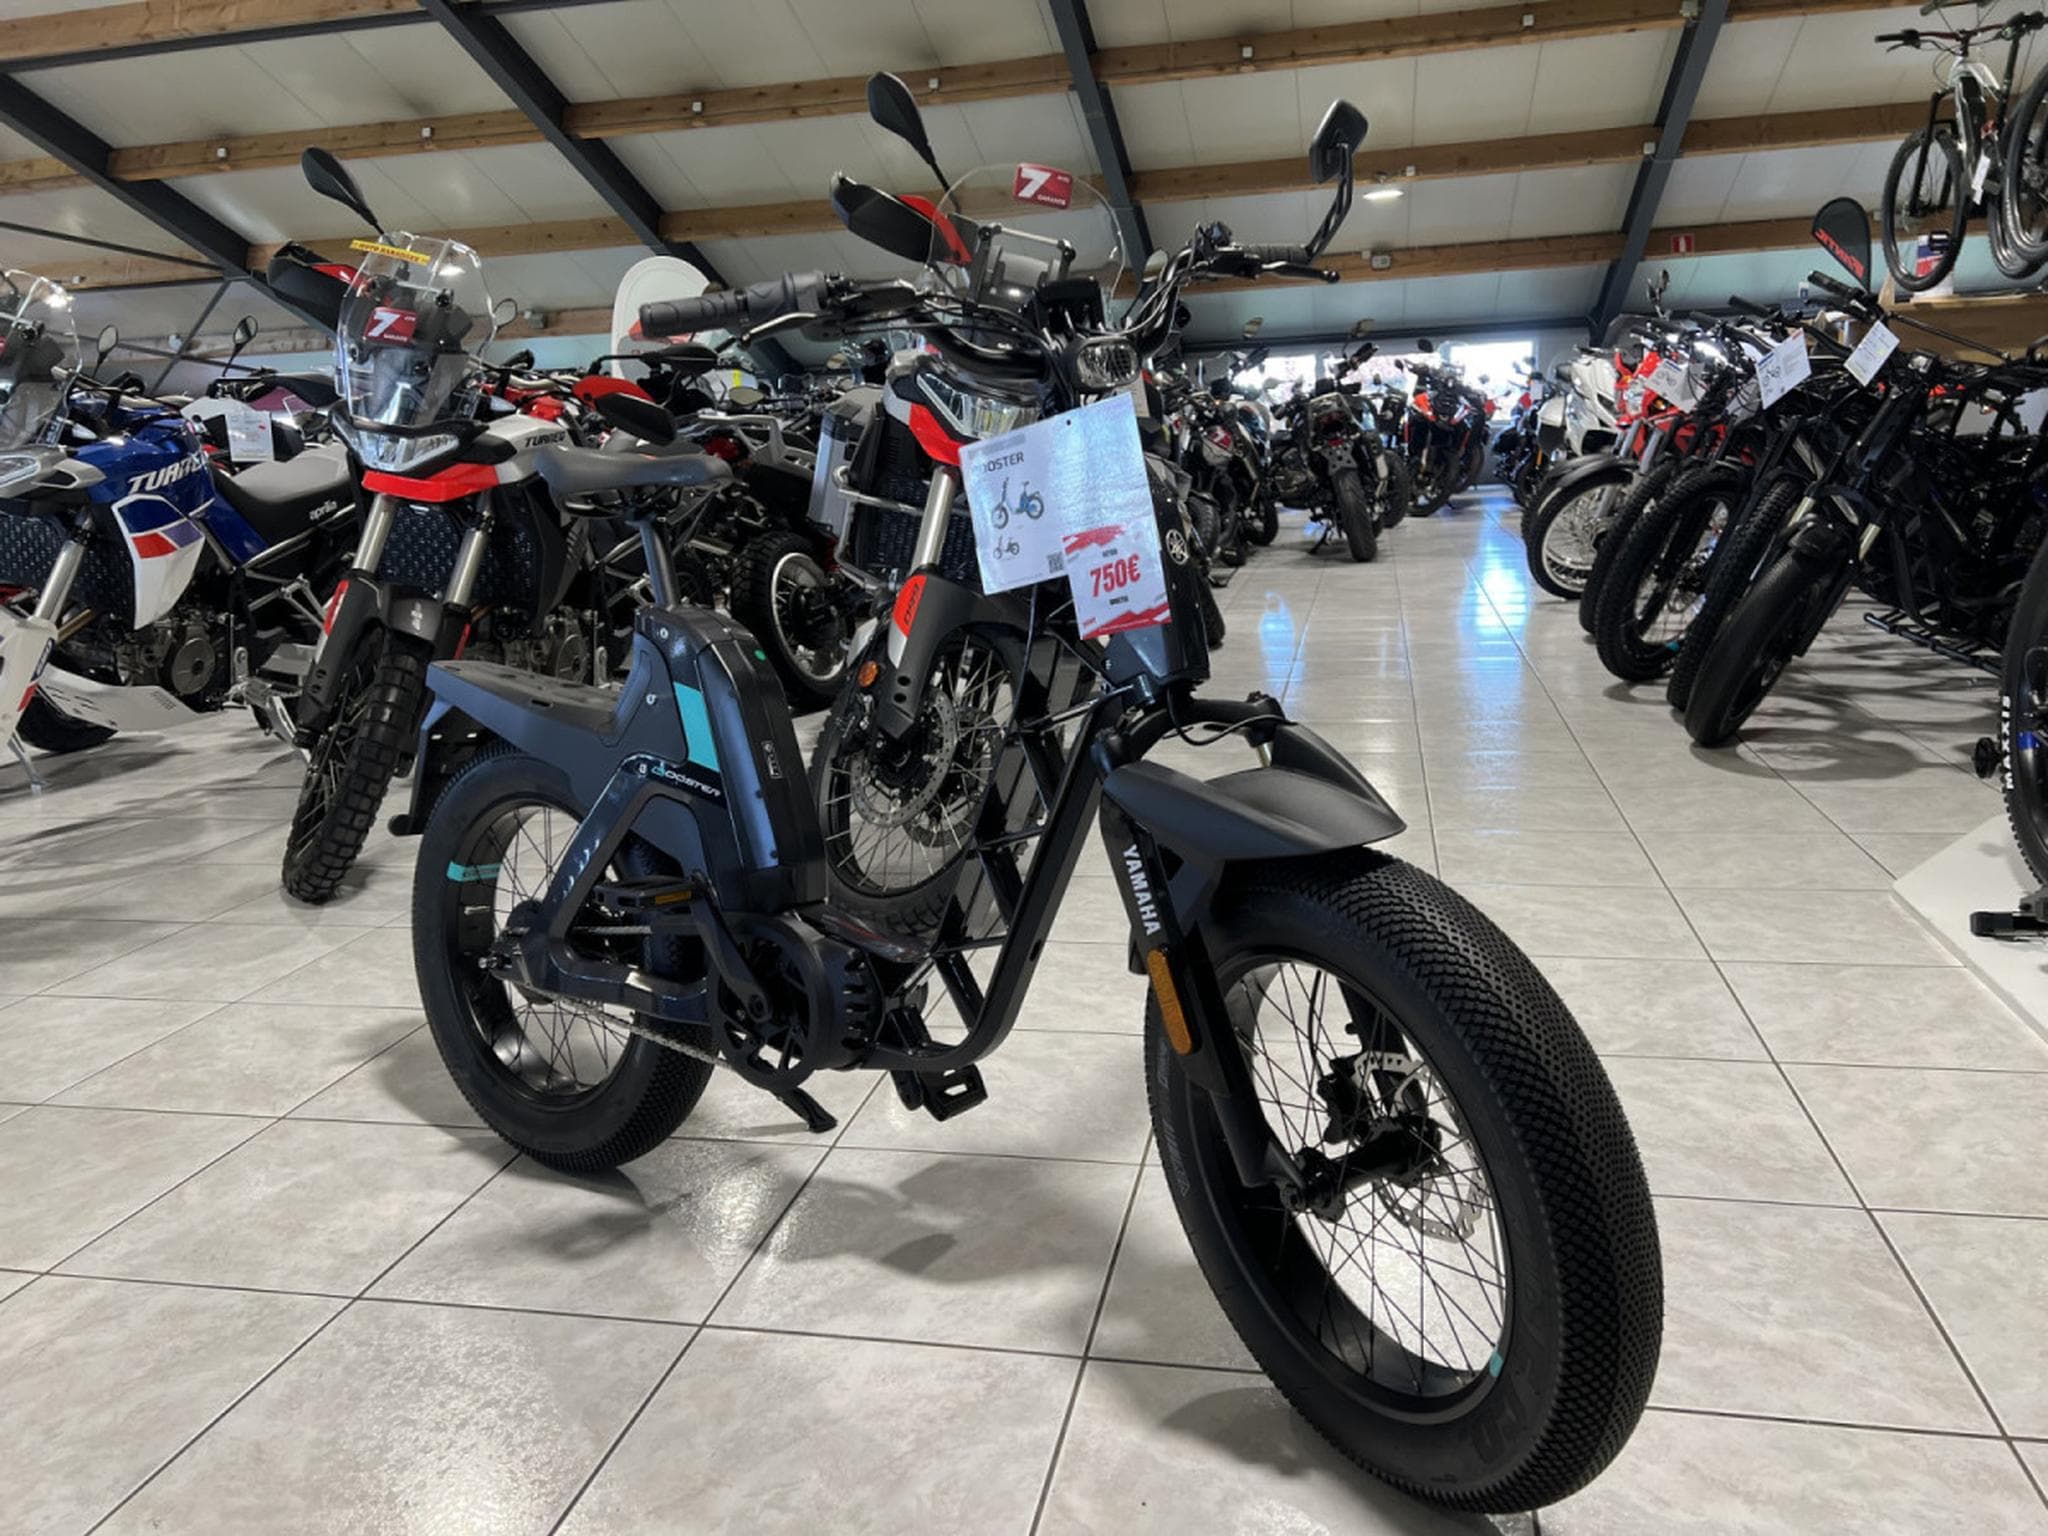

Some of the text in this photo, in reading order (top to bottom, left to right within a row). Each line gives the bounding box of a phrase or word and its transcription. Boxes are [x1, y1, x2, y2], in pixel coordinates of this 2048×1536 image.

[1018, 167, 1052, 198] 7
[367, 311, 401, 337] 7
[1089, 553, 1141, 598] 750€
[2001, 695, 2014, 790] MAXXIS
[1123, 843, 1161, 936] YAMAHA
